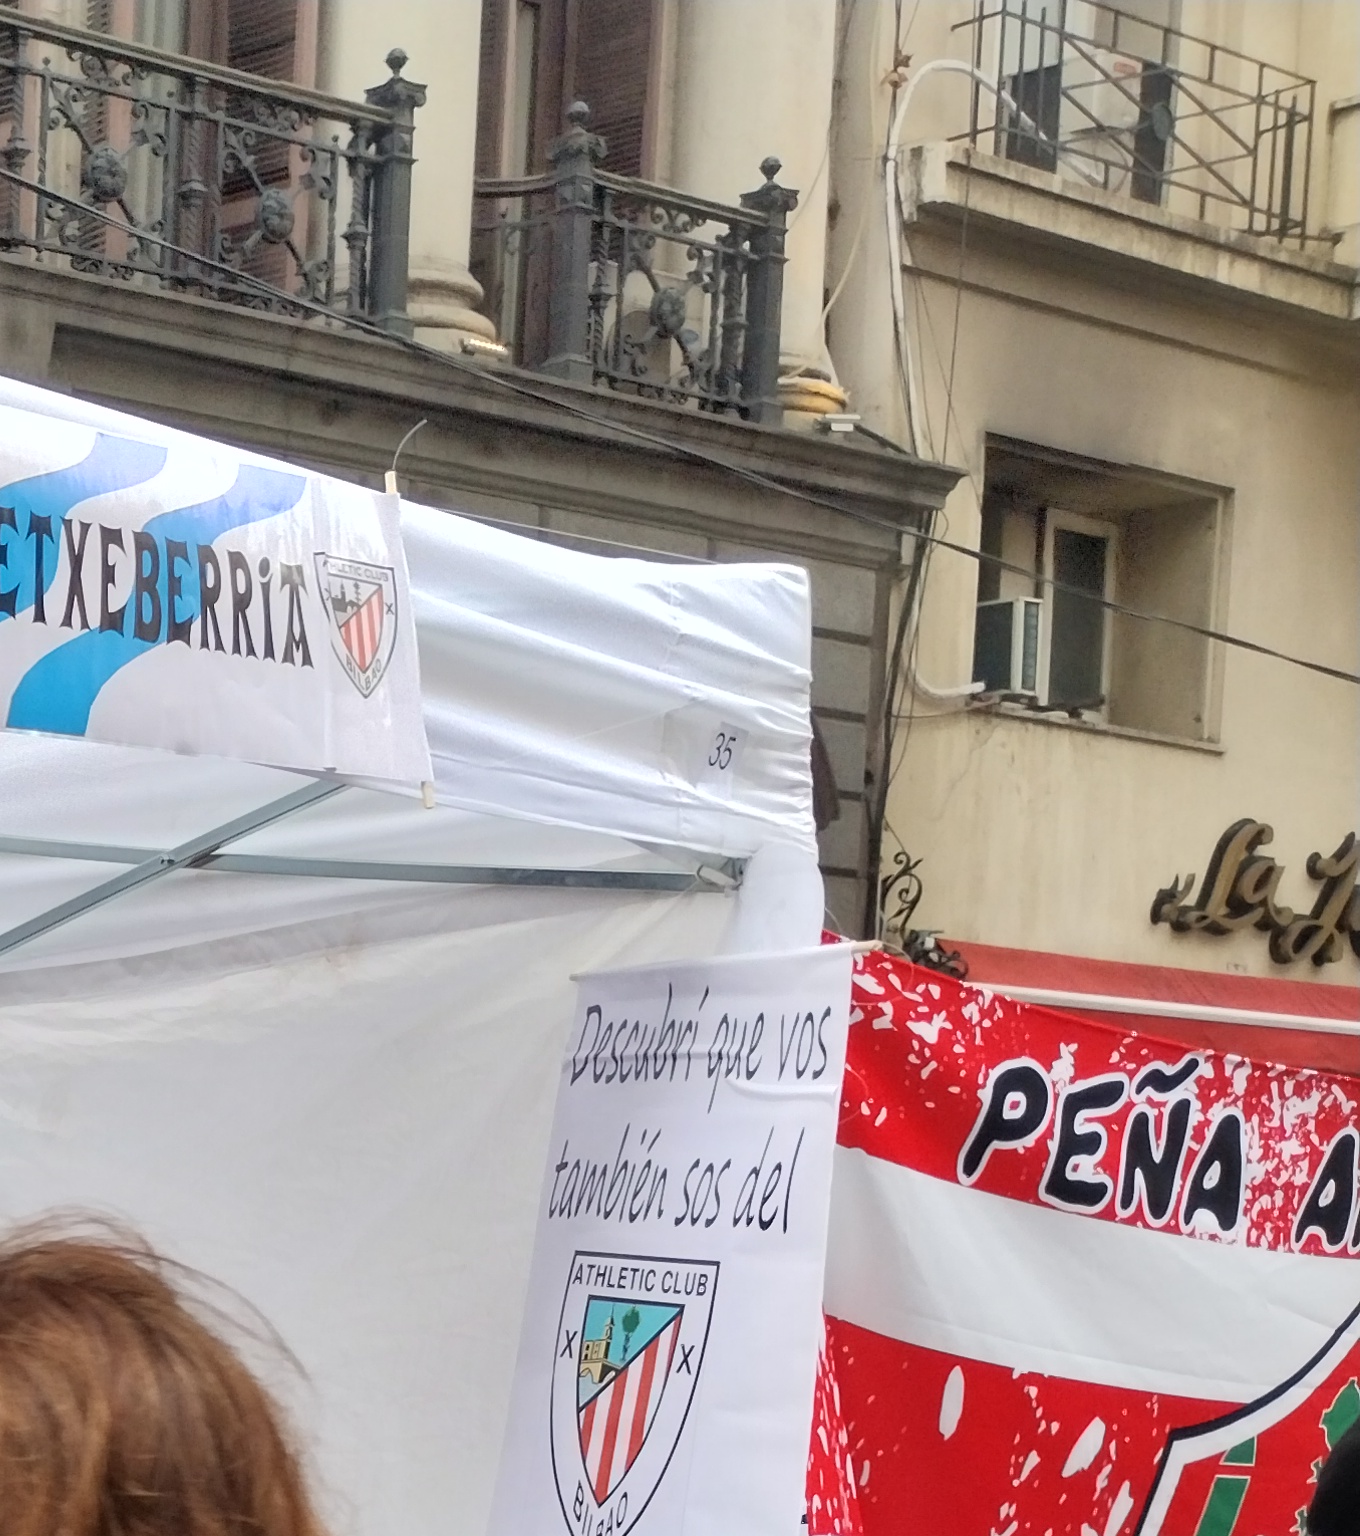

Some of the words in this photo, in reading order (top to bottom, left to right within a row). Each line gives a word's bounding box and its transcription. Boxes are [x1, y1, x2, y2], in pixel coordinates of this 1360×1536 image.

[708, 732, 737, 770] 35
[570, 982, 709, 1087] Descubrí
[707, 1012, 765, 1114] que
[778, 1005, 831, 1082] vos
[548, 1122, 668, 1224] también
[674, 1157, 732, 1228] sos
[732, 1126, 805, 1234] del
[961, 1057, 1244, 1232] PEÑA
[1294, 1131, 1360, 1250] A
[572, 1263, 656, 1292] ATHLETIC
[661, 1270, 709, 1296] CLUB
